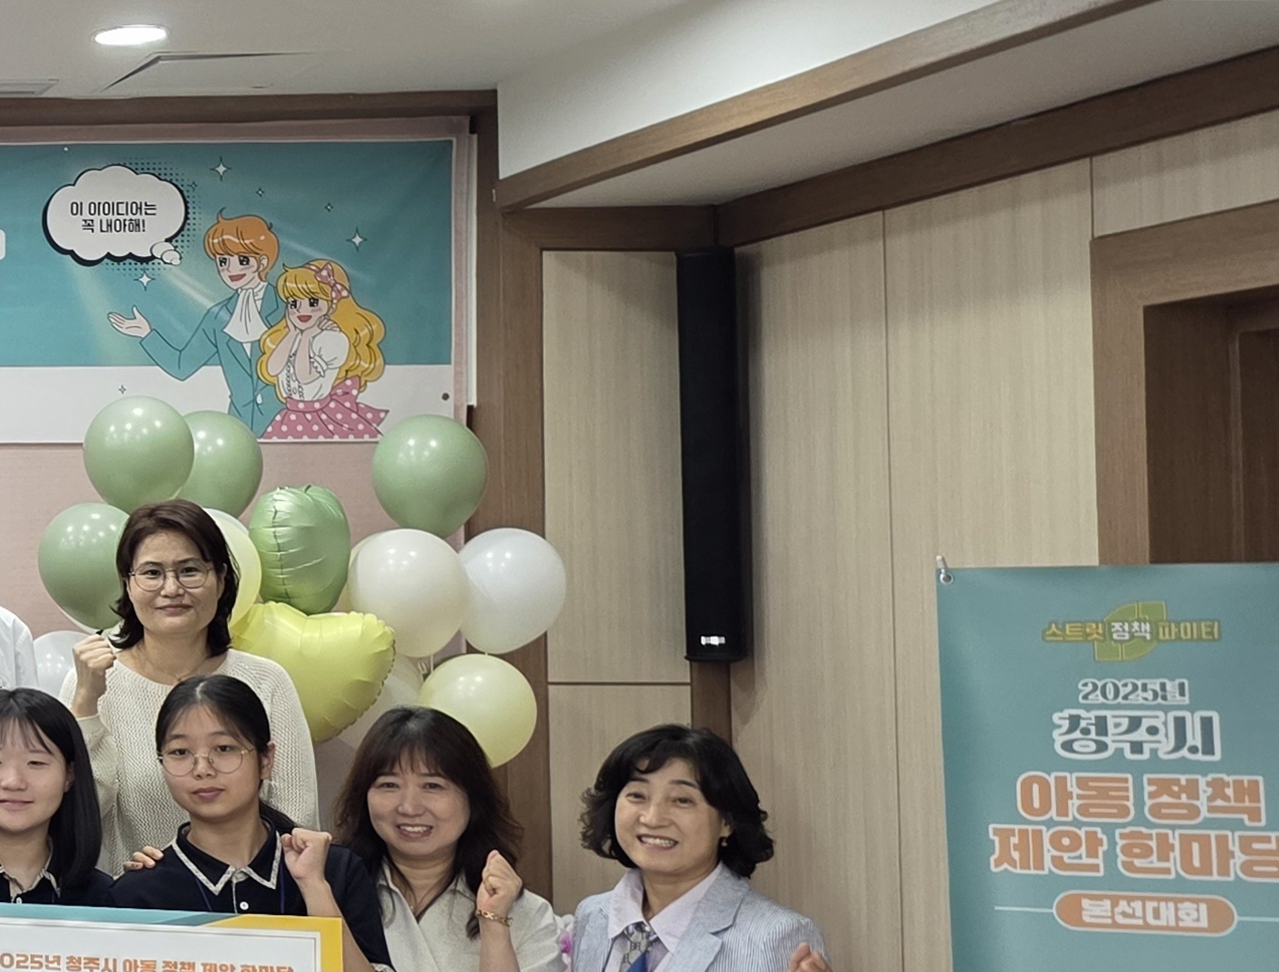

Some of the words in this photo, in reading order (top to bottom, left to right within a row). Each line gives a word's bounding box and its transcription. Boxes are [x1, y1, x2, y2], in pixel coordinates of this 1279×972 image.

[70, 201, 83, 216] 이
[88, 201, 157, 216] 아이디어는
[82, 219, 95, 233] 꼭
[1043, 621, 1105, 642] 스트릿
[1110, 620, 1151, 641] 정책
[1157, 620, 1221, 642] 파이터
[1079, 679, 1189, 704] 2025년
[1053, 709, 1221, 760] 청주시
[1017, 772, 1133, 822] 아동
[1143, 774, 1265, 826] 정책
[990, 825, 1107, 875] 제안
[1081, 897, 1209, 928] 본선대회
